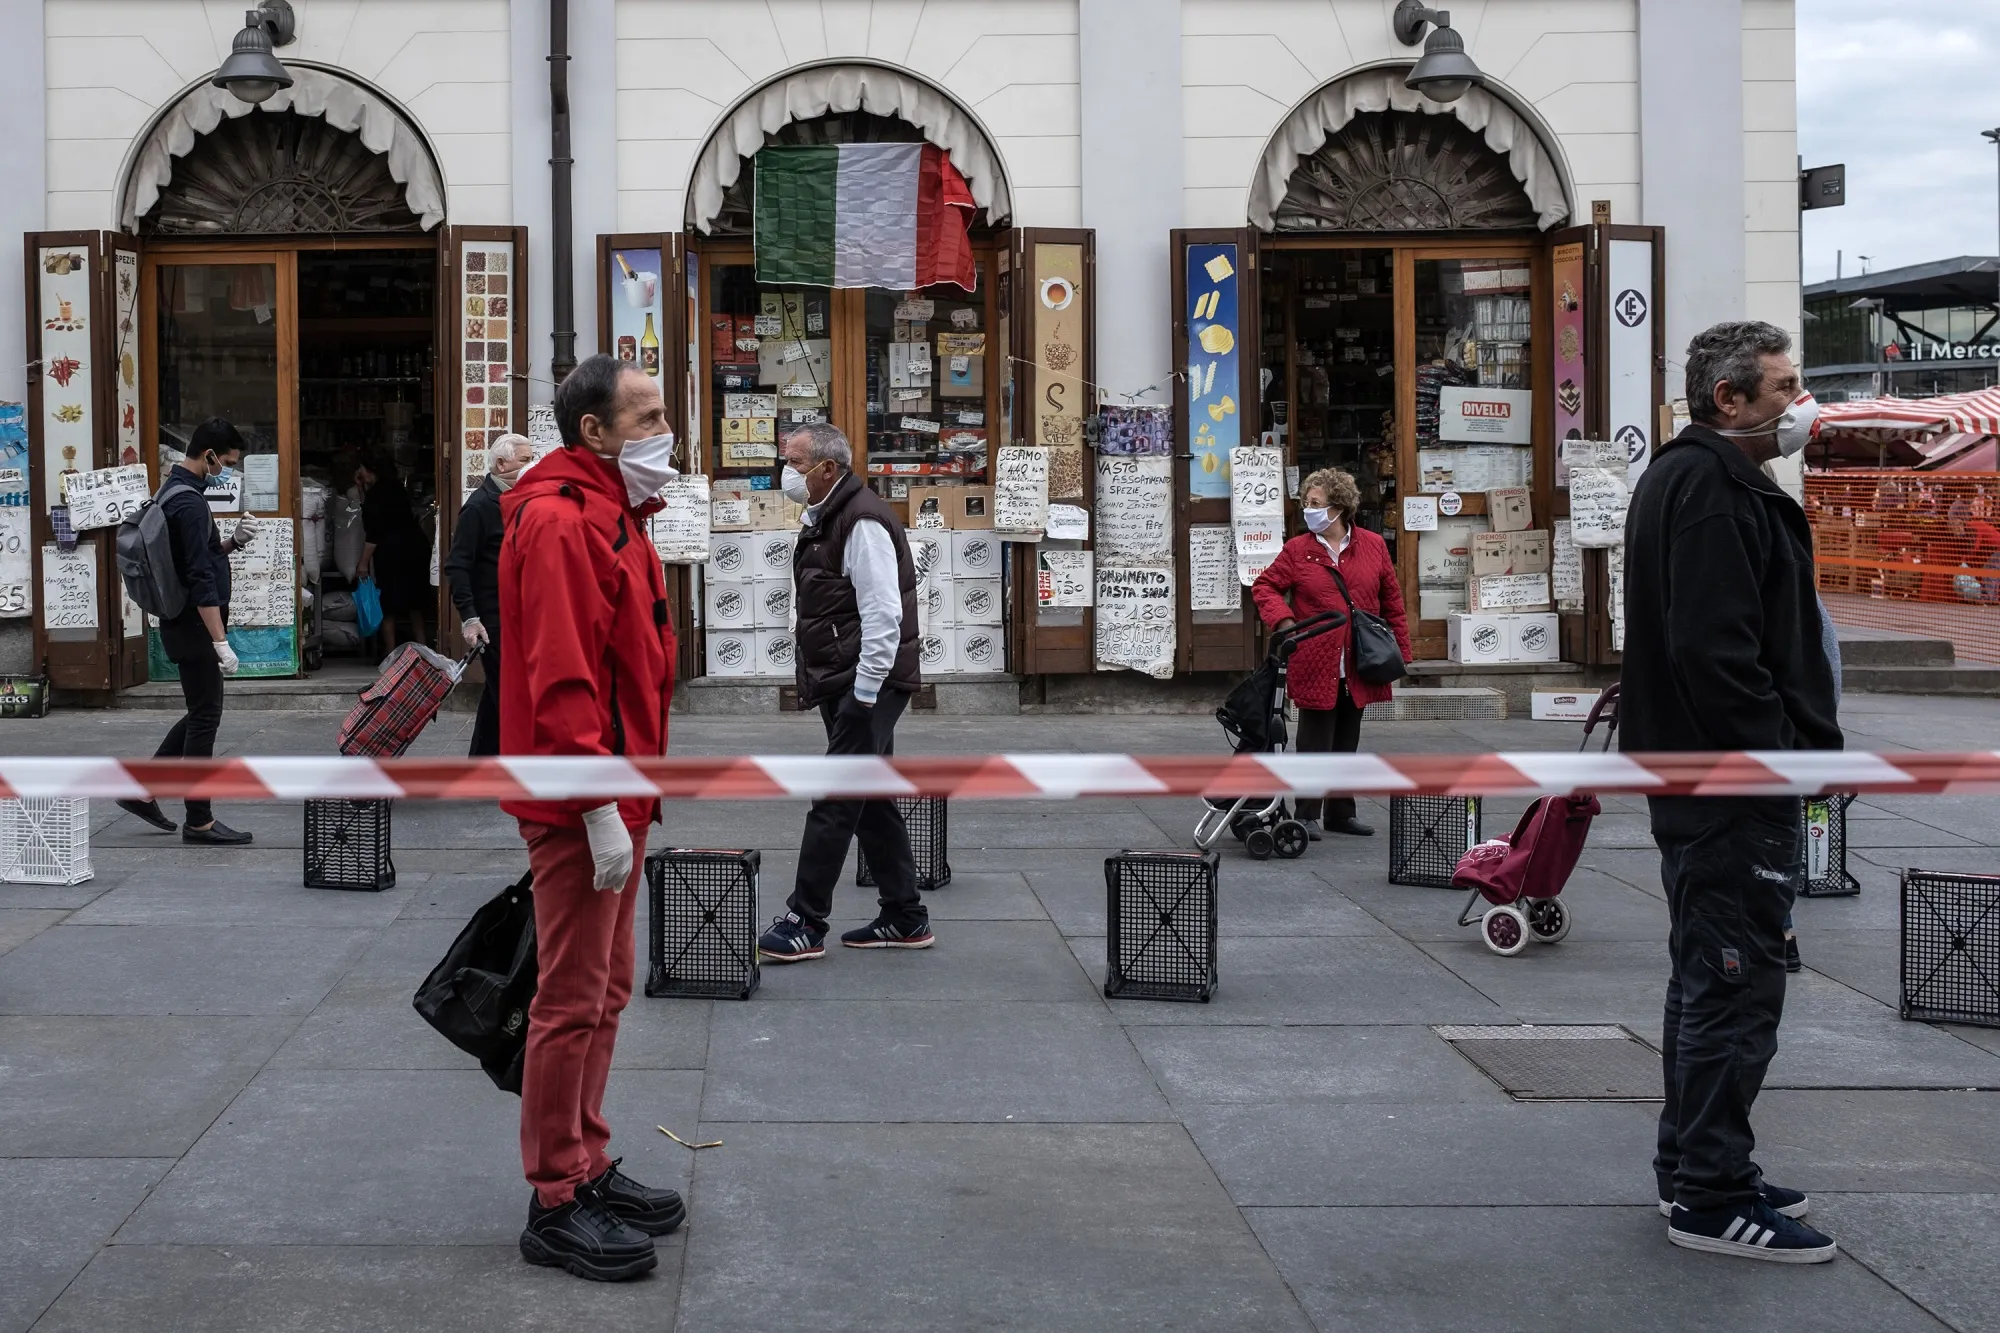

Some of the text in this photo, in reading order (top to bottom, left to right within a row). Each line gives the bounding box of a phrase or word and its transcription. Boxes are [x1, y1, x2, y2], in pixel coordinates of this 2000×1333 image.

[1597, 204, 1607, 212] 26
[1558, 247, 1580, 255] BISCOTTI
[1910, 342, 1922, 361] il
[1463, 402, 1509, 417] DIVELLA
[1000, 449, 1042, 461] SESAMO
[1097, 461, 1138, 475] VASTO
[66, 471, 112, 492] MIELE
[1109, 486, 1141, 495] SPEZIE
[1495, 489, 1526, 498] CREMOSO
[1145, 520, 1163, 530] PEPE
[1406, 515, 1434, 525] USCITA
[1244, 531, 1272, 542] inalpi
[720, 554, 739, 569] 1882
[770, 550, 788, 566] 1882
[969, 549, 988, 565] 1882
[1100, 584, 1136, 598] PASTA
[1470, 580, 1478, 611] CREMOSO
[721, 600, 740, 616] 1882
[970, 598, 989, 613] 1882
[1124, 604, 1169, 621] 1,80
[50, 612, 88, 626] 16,00
[1477, 635, 1496, 651] 1882
[1526, 634, 1545, 649] 1882
[723, 649, 740, 664] 1882
[773, 647, 791, 663] 1882
[971, 645, 990, 660] 1882
